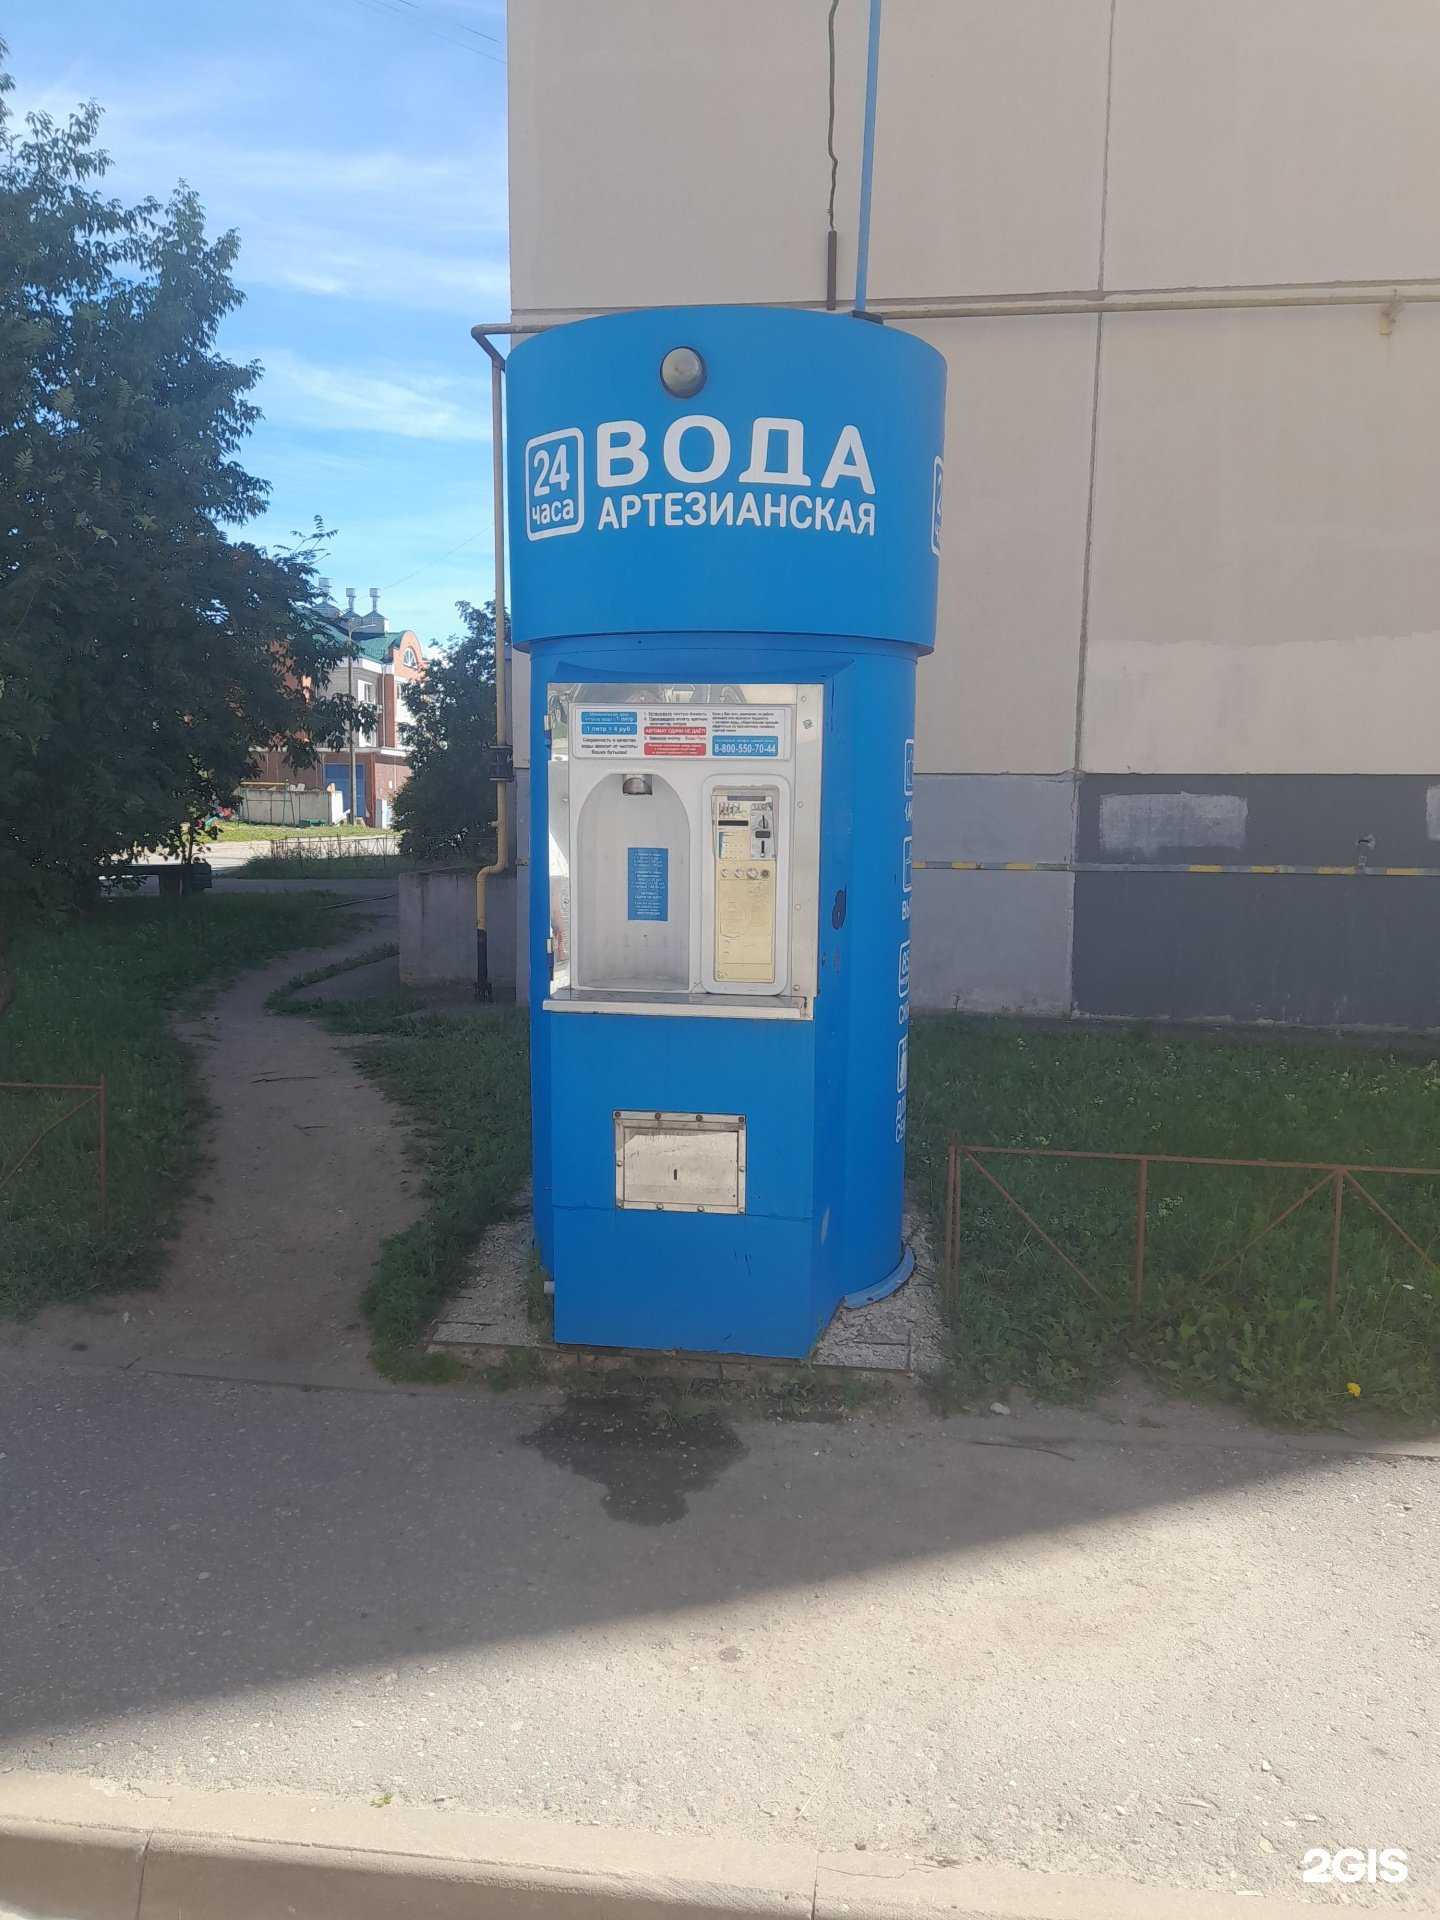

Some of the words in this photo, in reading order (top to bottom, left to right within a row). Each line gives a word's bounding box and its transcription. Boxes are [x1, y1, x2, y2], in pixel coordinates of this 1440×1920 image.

[532, 444, 570, 497] 24
[596, 414, 876, 495] ВОДА
[532, 497, 575, 526] часа
[598, 491, 877, 537] АРТЕЗИАНСКАЯ
[714, 743, 776, 753] 8-800-550-70-44
